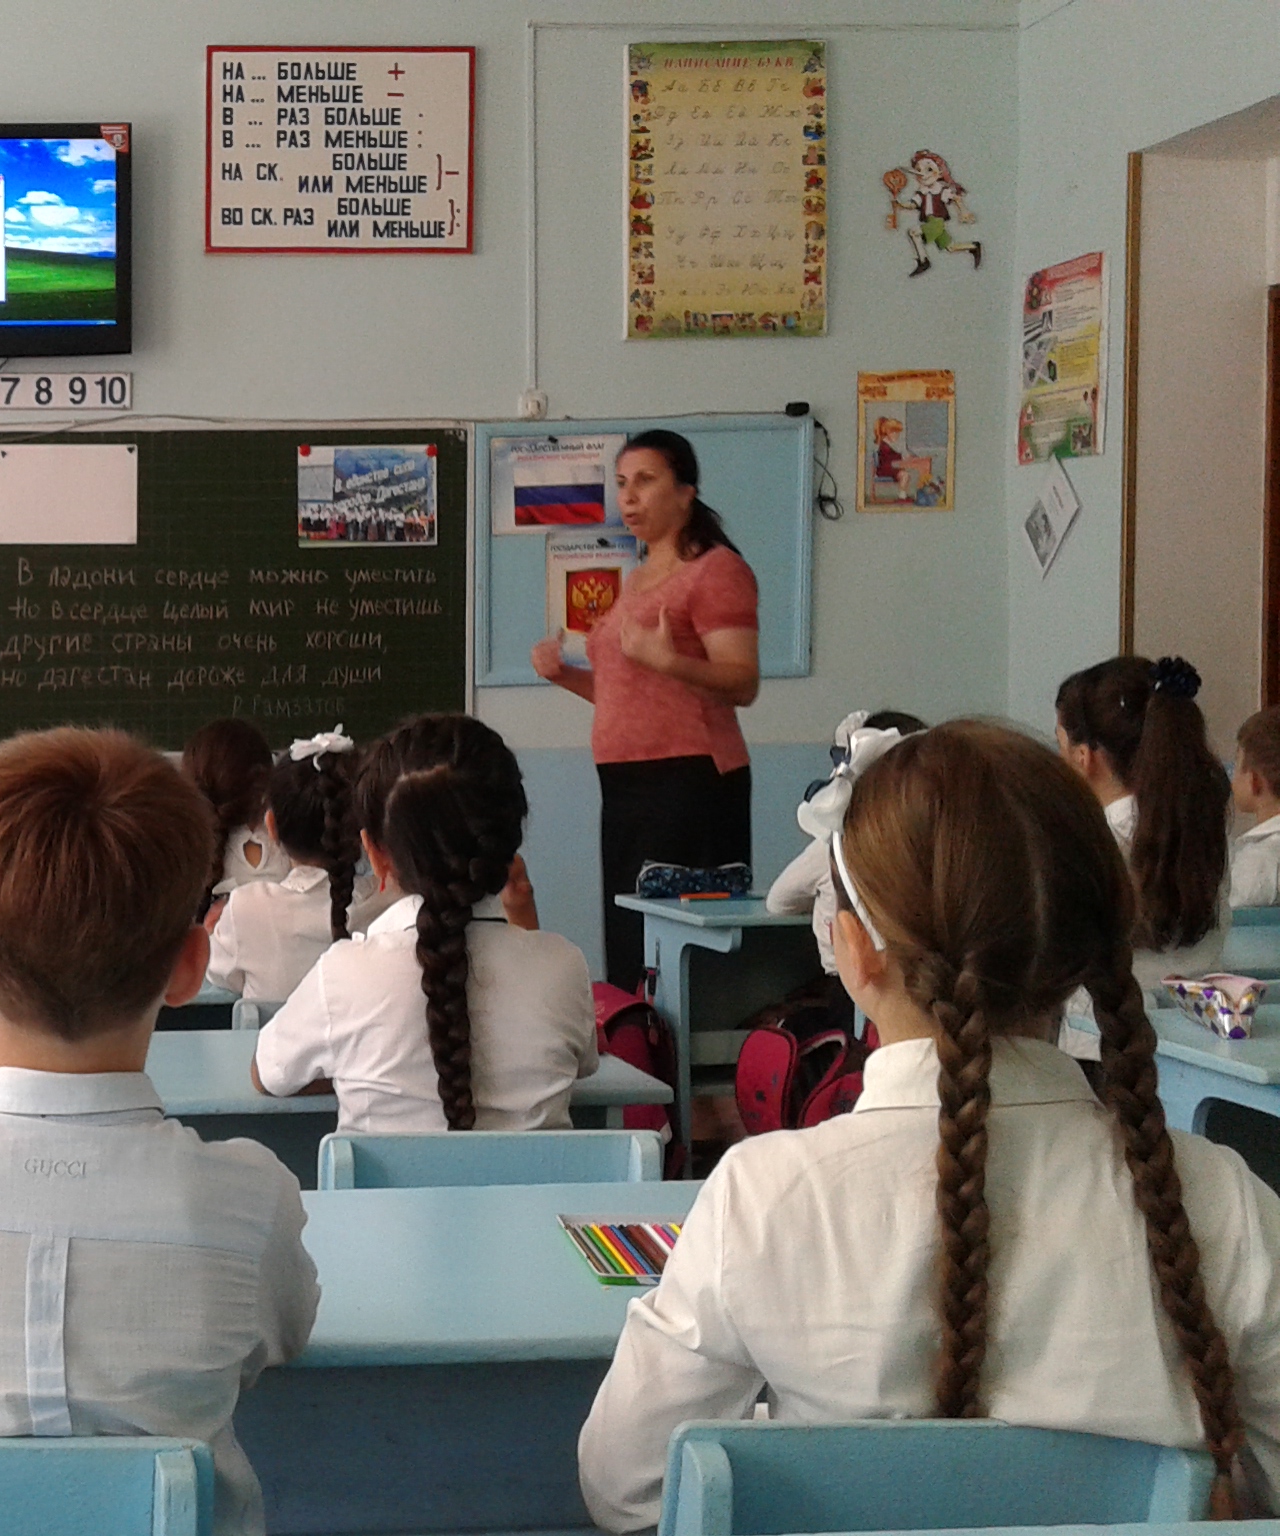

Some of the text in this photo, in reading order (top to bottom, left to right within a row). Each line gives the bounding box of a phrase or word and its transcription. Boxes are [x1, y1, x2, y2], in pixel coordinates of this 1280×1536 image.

[222, 62, 357, 80] НА БОЛЬШЕ
[222, 85, 363, 103] НА МЕНЬШЕ
[222, 108, 401, 126] В РАЗ БОЛЬШЕ
[222, 130, 408, 148] В РАЗ МЕНЬШЕ
[221, 153, 407, 181] НА СК. БОЛЬШЕ
[298, 175, 427, 193] ИЛИ МЕНЬШЕ
[221, 198, 411, 225] ВО СК. РАЗ БОЛЬШЕ
[327, 220, 445, 238] ИЛИ МЕНЬШЕ
[0, 377, 20, 404] 7
[35, 377, 53, 404] 8
[69, 377, 87, 404] 9
[95, 376, 126, 404] 10
[17, 556, 437, 593] В ладони сердце можно уместить
[70, 602, 151, 625] сердце
[111, 632, 192, 654] страны
[218, 632, 277, 654] очень
[260, 663, 307, 688] для
[321, 664, 382, 688] души
[24, 1158, 87, 1178] GUCCI
